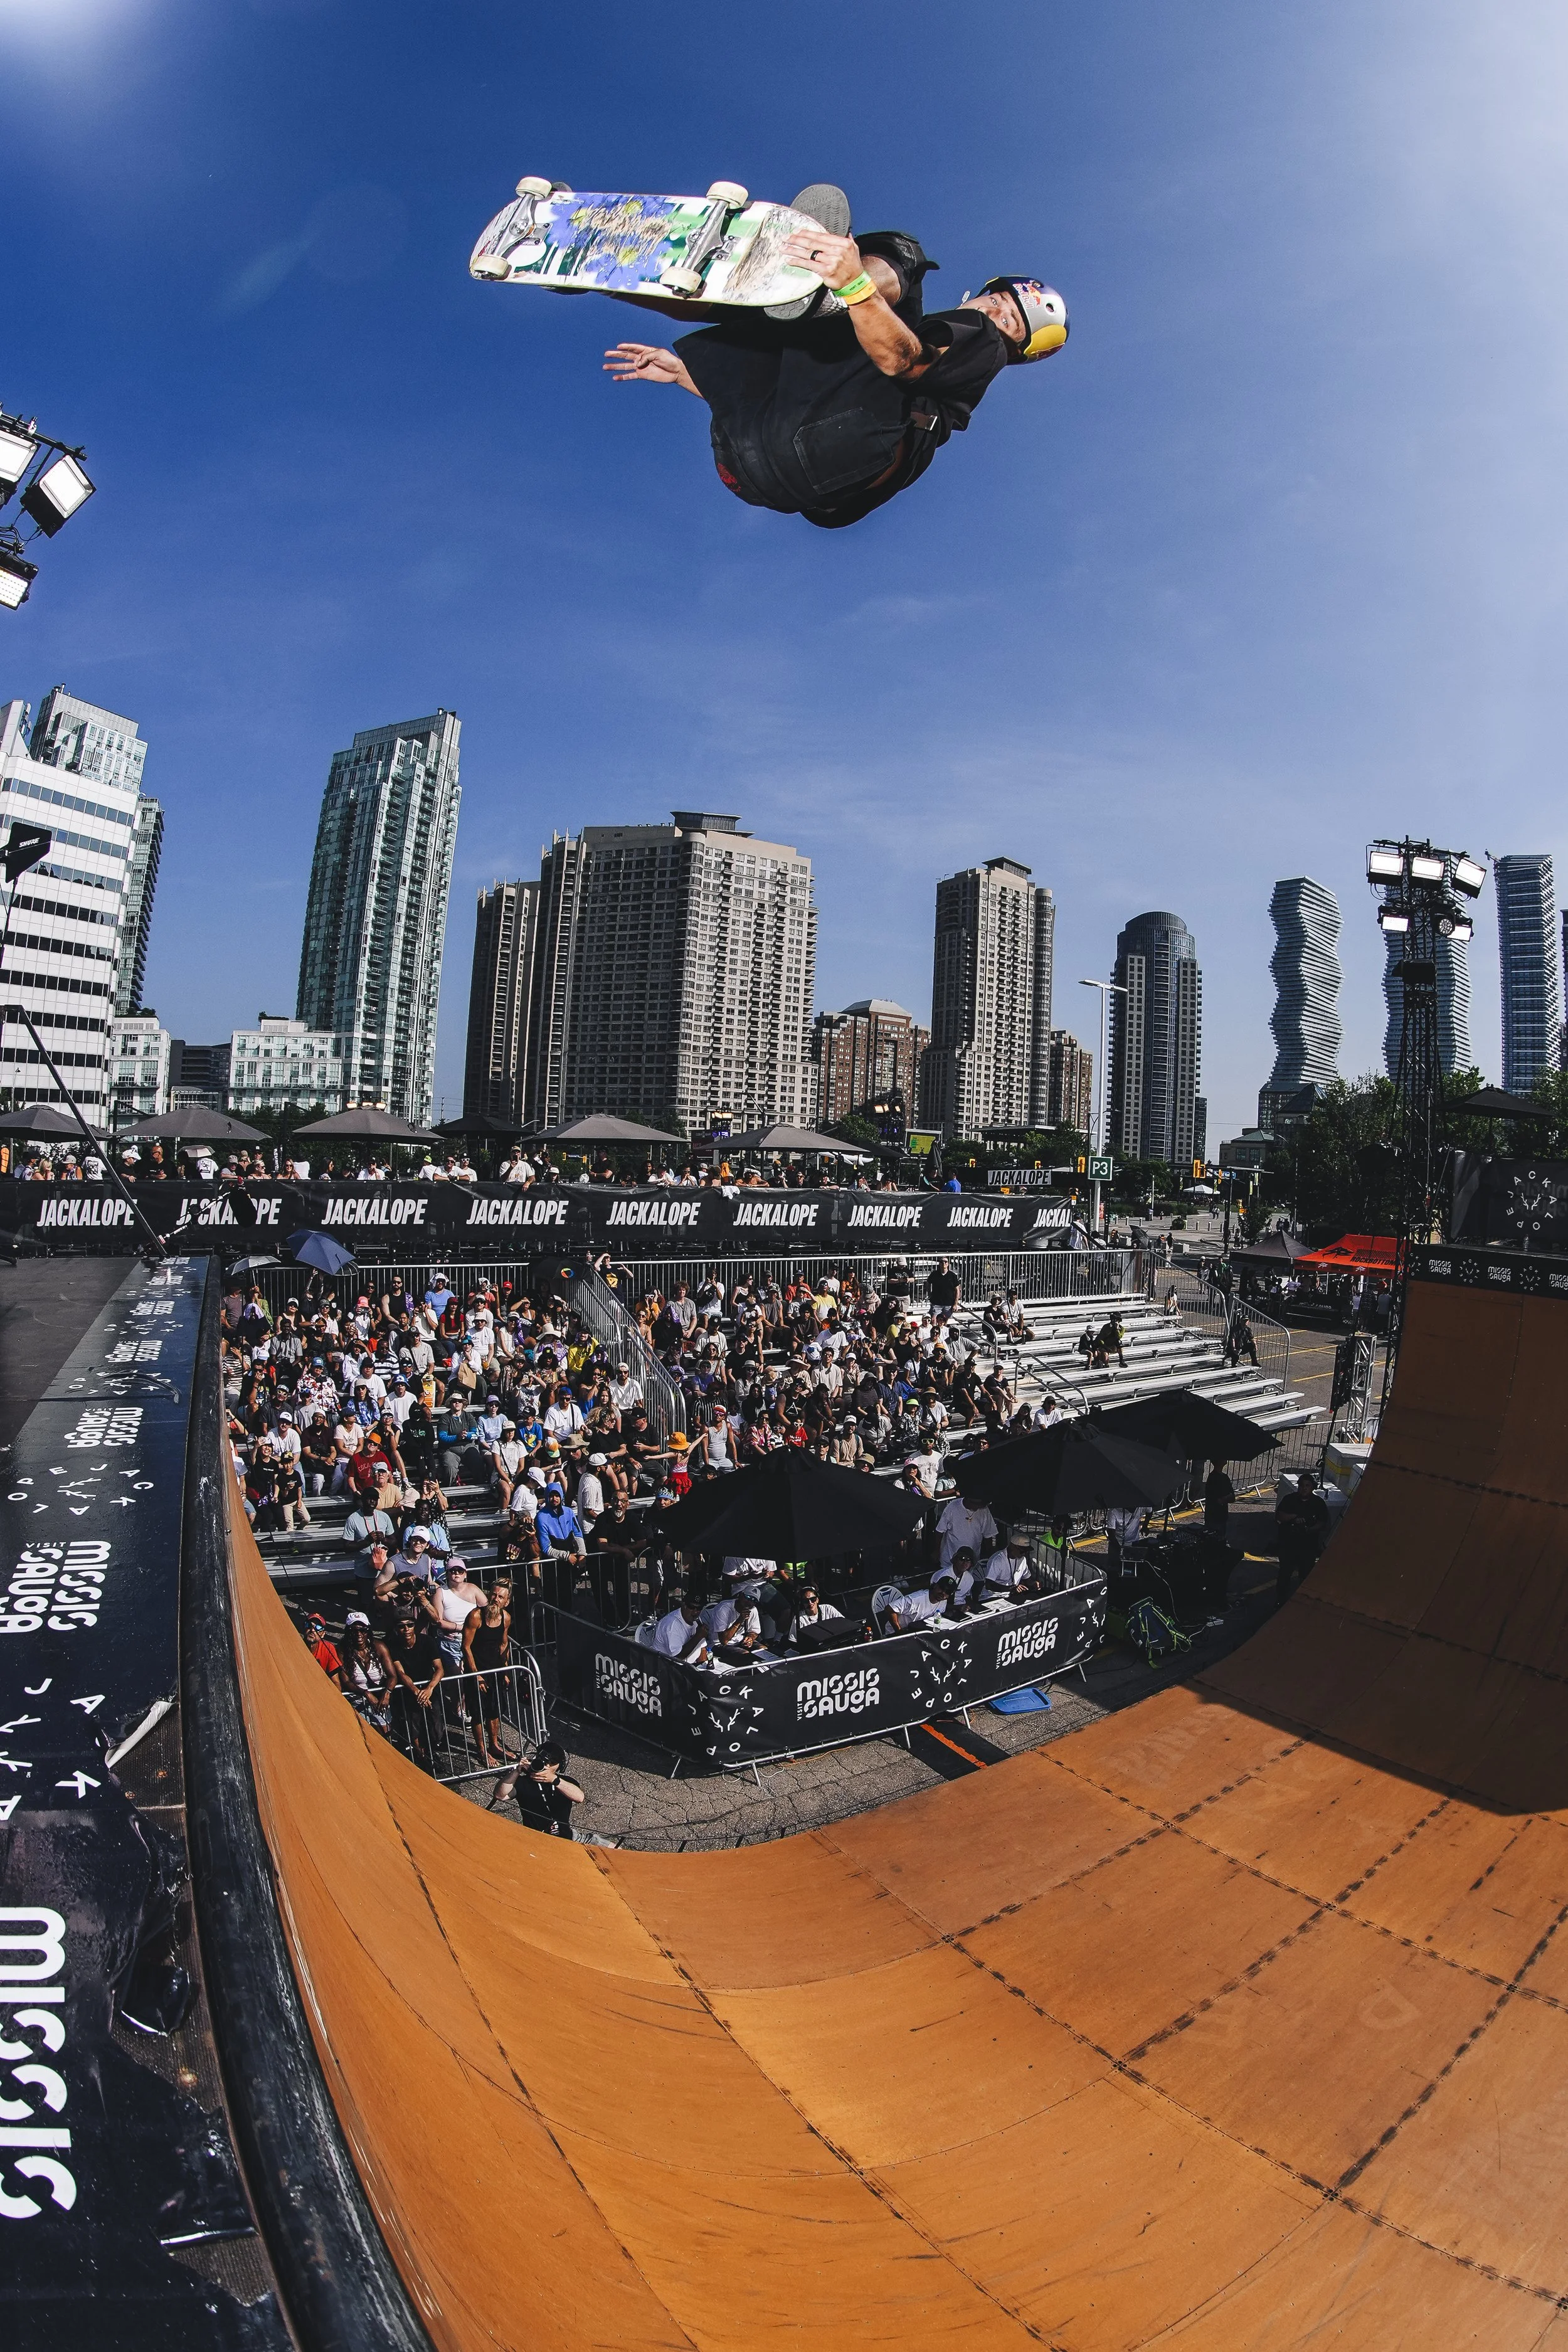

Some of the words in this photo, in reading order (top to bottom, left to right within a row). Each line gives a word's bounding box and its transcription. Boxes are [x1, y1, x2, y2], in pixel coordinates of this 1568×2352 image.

[19, 837, 40, 847] SHURE
[989, 1170, 1049, 1185] JACKALOPE
[1092, 1161, 1108, 1175] P3
[36, 1199, 137, 1227] JACKALOPE
[321, 1199, 428, 1225] JACKALOPE
[466, 1199, 569, 1225] JACKALOPE
[606, 1201, 701, 1226] JACKALOPE
[733, 1204, 818, 1226] JACKALOPE
[847, 1205, 923, 1227] JACKALOPE
[947, 1207, 1014, 1227] JACKALOPE
[1549, 1273, 1568, 1282] MISSI
[1550, 1280, 1568, 1290] SAUG
[64, 1411, 112, 1448] SAUGA
[103, 1407, 144, 1446] MISSIS
[47, 1540, 112, 1631] MISSIS
[998, 1617, 1059, 1652] MISSIS
[1002, 1633, 1056, 1666] SAUGA
[595, 1653, 660, 1695] MISSIS
[797, 1668, 880, 1702] MISSIS
[600, 1674, 662, 1717] SAUGA
[803, 1687, 880, 1719] SAUGA
